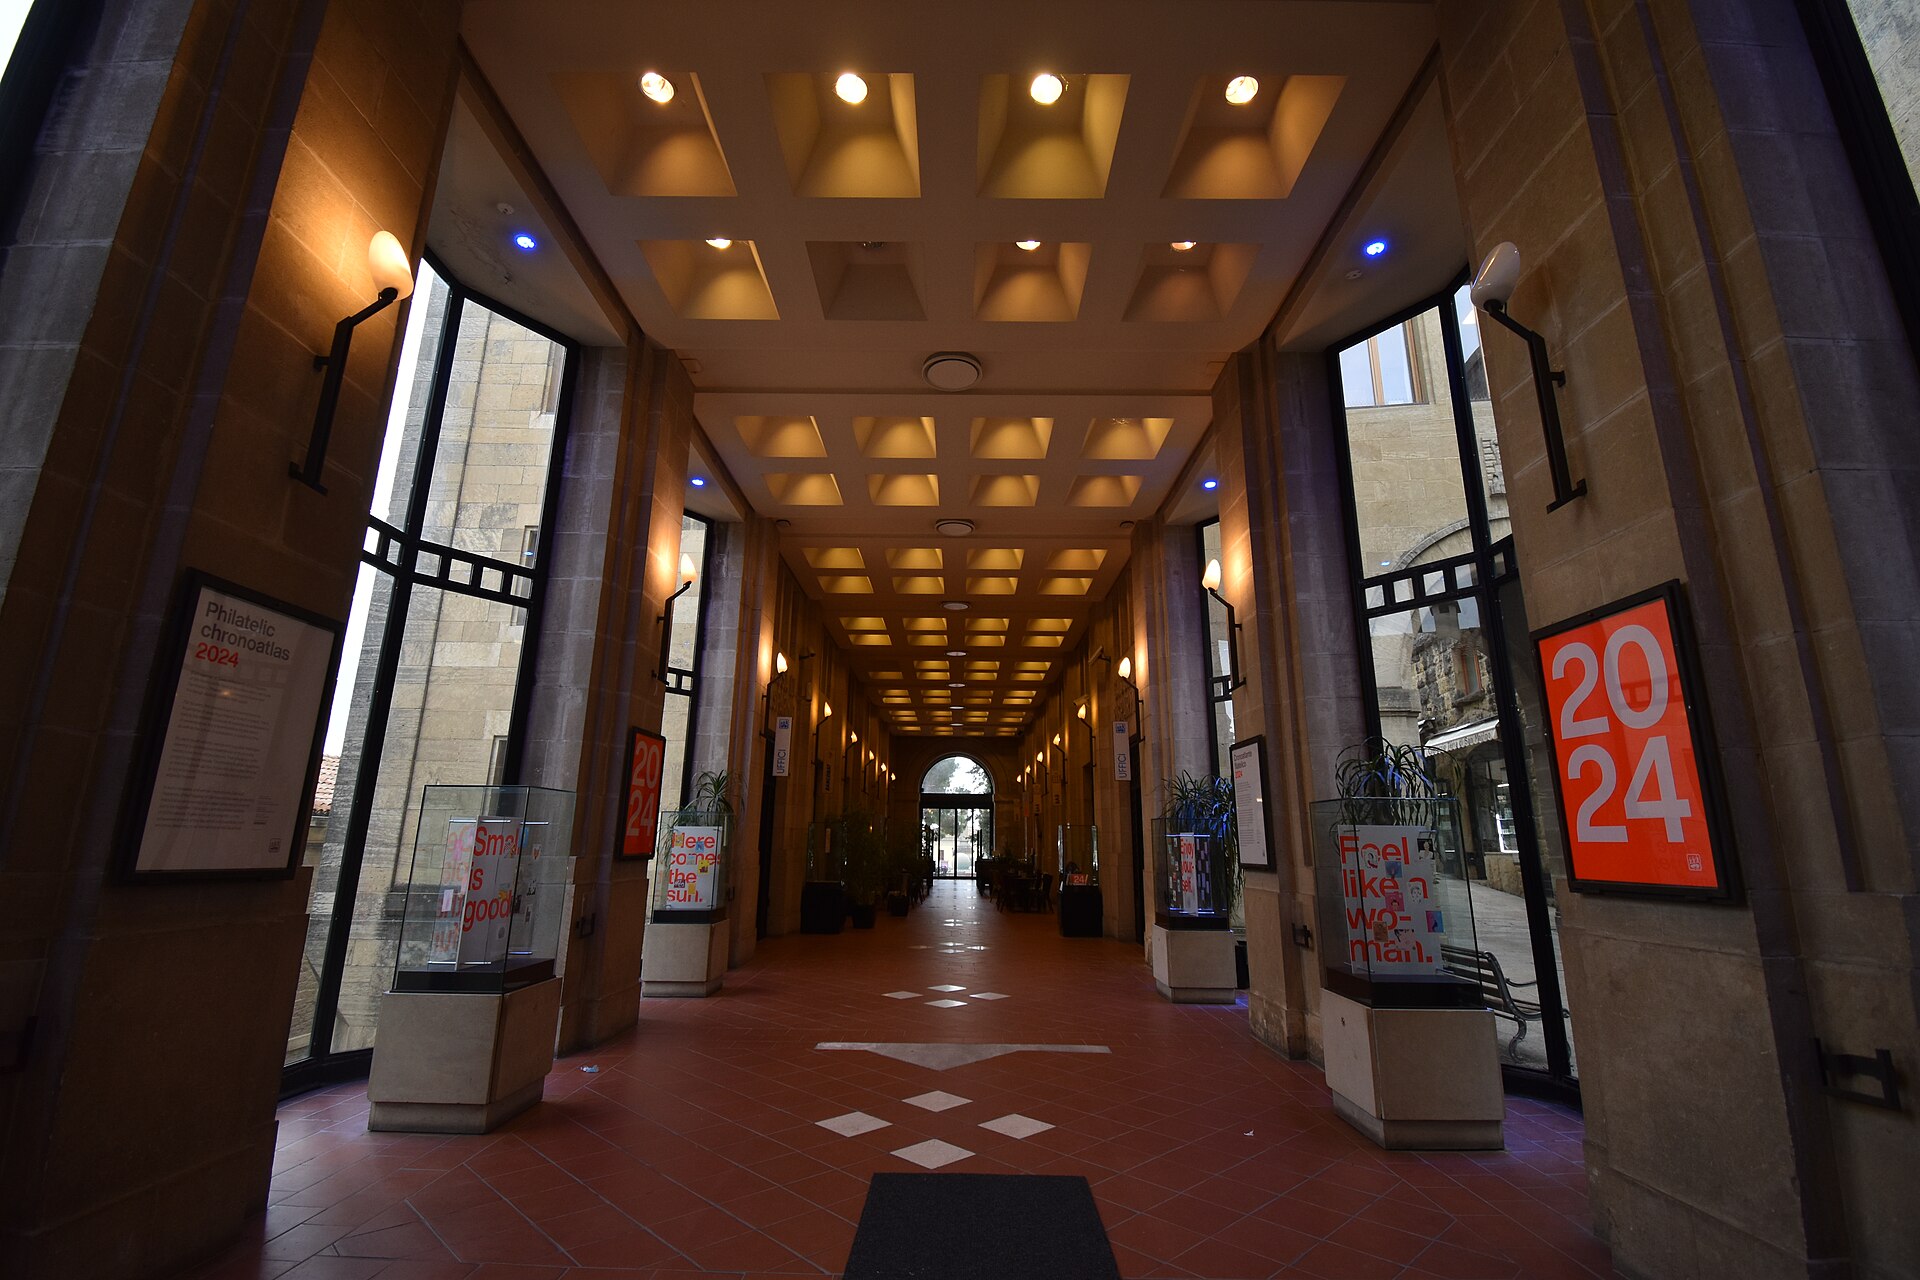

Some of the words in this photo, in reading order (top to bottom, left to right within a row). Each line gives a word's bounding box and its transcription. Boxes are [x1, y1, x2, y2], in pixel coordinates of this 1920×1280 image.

[205, 601, 276, 637] Philatelic
[195, 642, 240, 668] 2024
[201, 623, 290, 661] chronoatlas
[1551, 623, 1669, 740] 20
[632, 740, 660, 789] 20
[776, 749, 786, 774] UFFICI
[1117, 753, 1127, 778] UFFICI
[1567, 735, 1692, 843] 24
[625, 789, 654, 837] 24
[473, 825, 520, 856] Sml
[468, 861, 484, 891] is
[669, 868, 697, 885] the
[1343, 868, 1399, 898] like
[462, 889, 513, 932] good
[667, 889, 703, 903] sun.
[1346, 907, 1412, 930] wo-
[1349, 939, 1433, 963] man.
